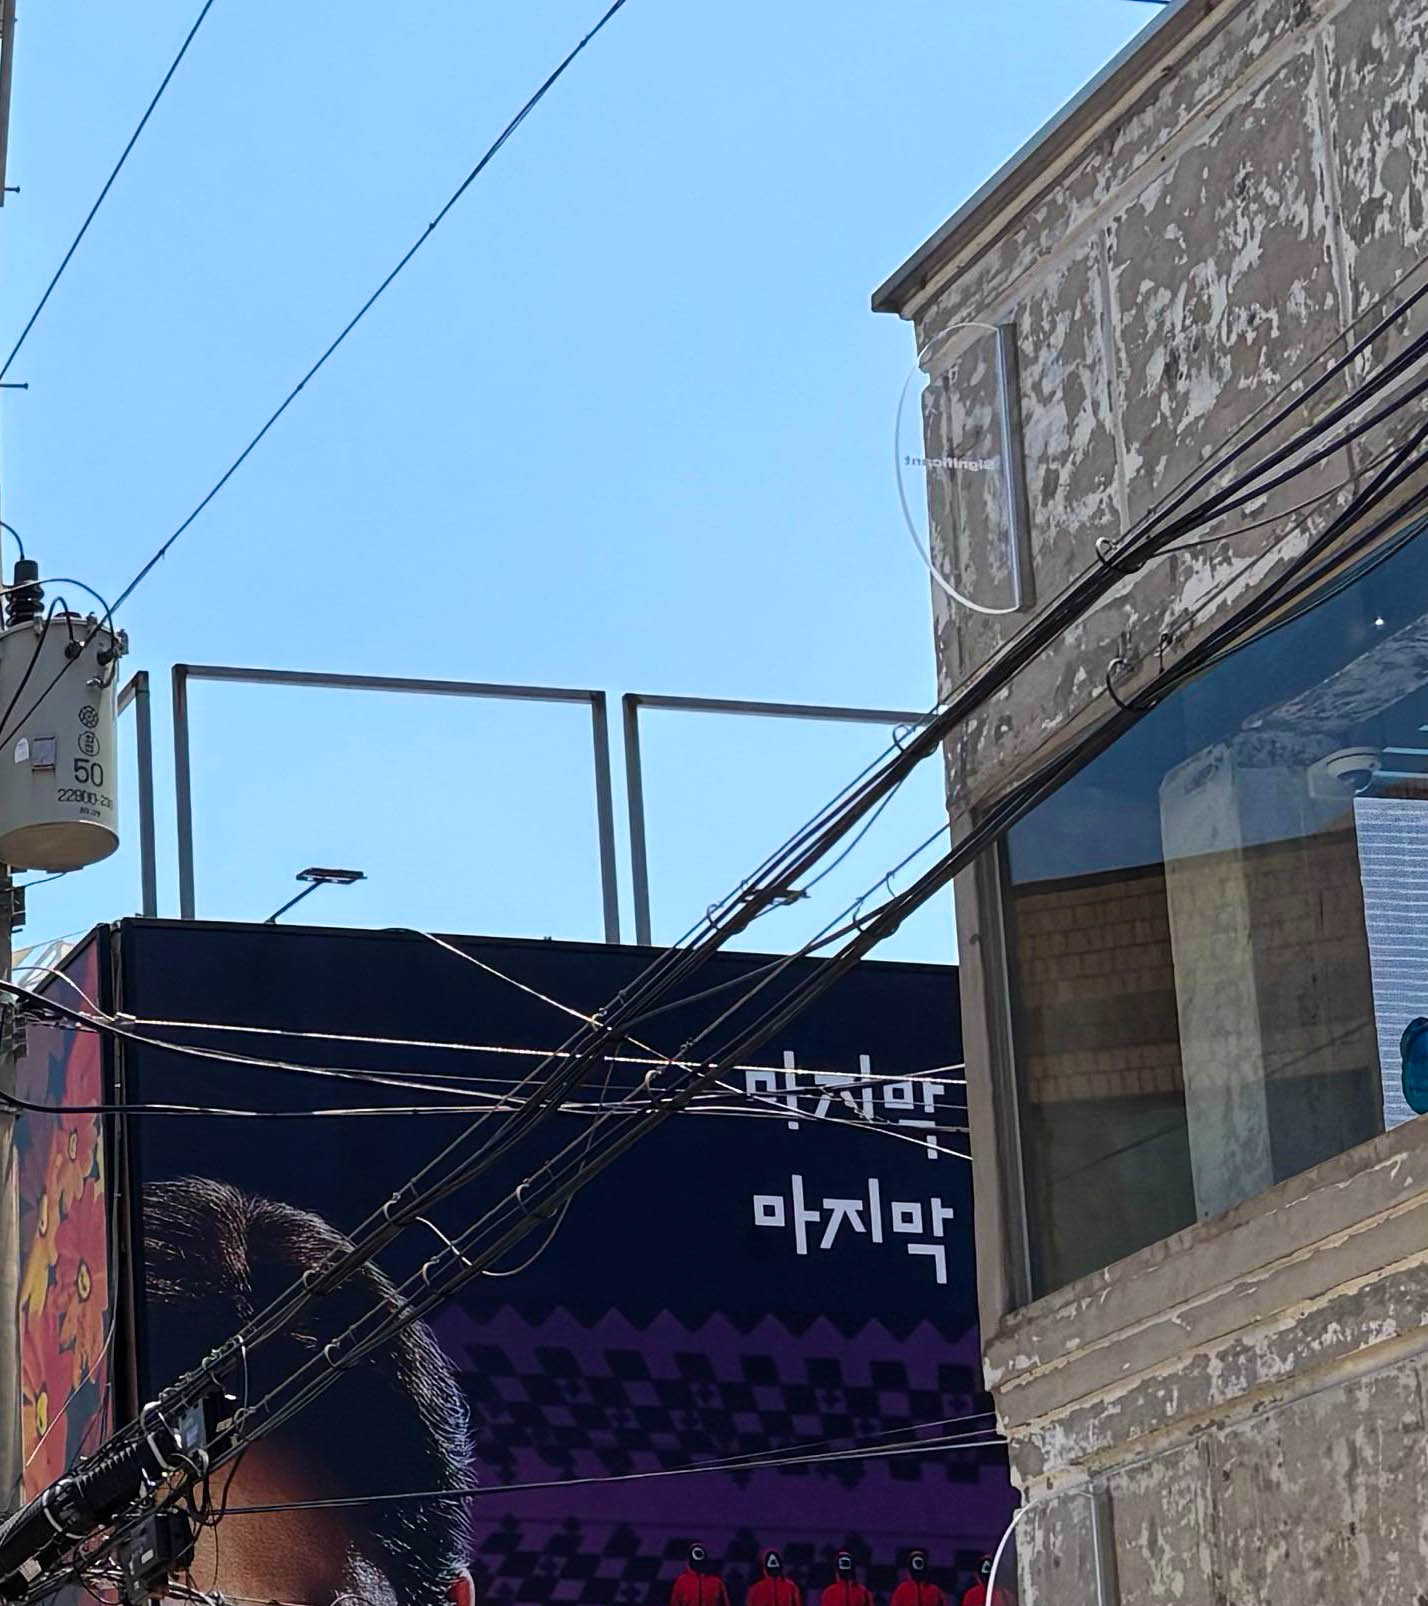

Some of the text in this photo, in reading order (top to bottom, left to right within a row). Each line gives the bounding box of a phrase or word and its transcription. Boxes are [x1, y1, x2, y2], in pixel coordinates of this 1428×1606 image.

[73, 758, 104, 787] 50
[745, 1051, 946, 1160] 마지막
[753, 1174, 956, 1285] 마지막
